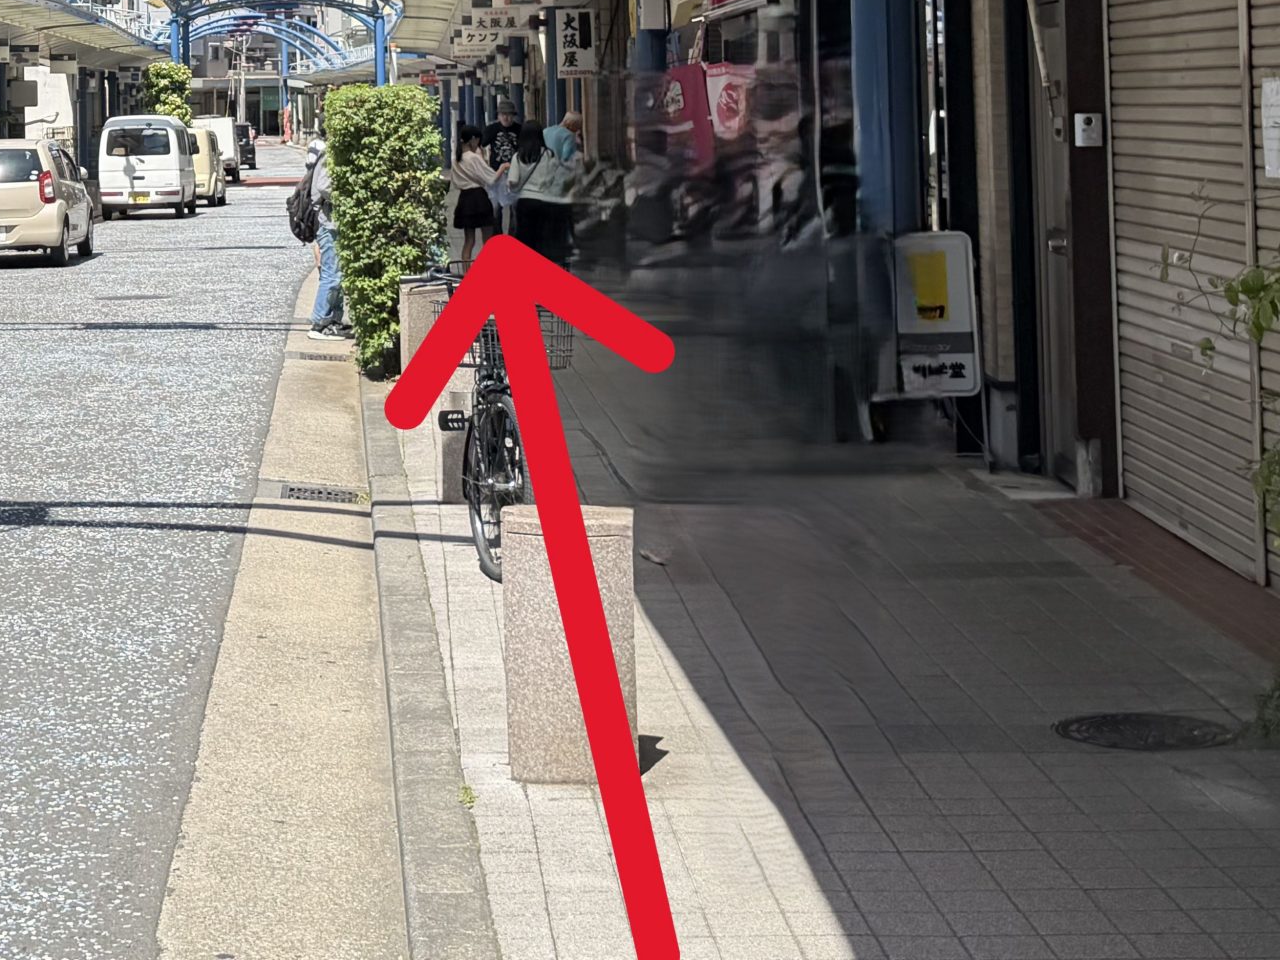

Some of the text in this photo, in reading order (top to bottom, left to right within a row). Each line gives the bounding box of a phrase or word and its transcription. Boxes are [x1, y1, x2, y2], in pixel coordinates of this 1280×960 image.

[475, 16, 518, 29] 大阪屋
[561, 12, 579, 68] 大阪屋
